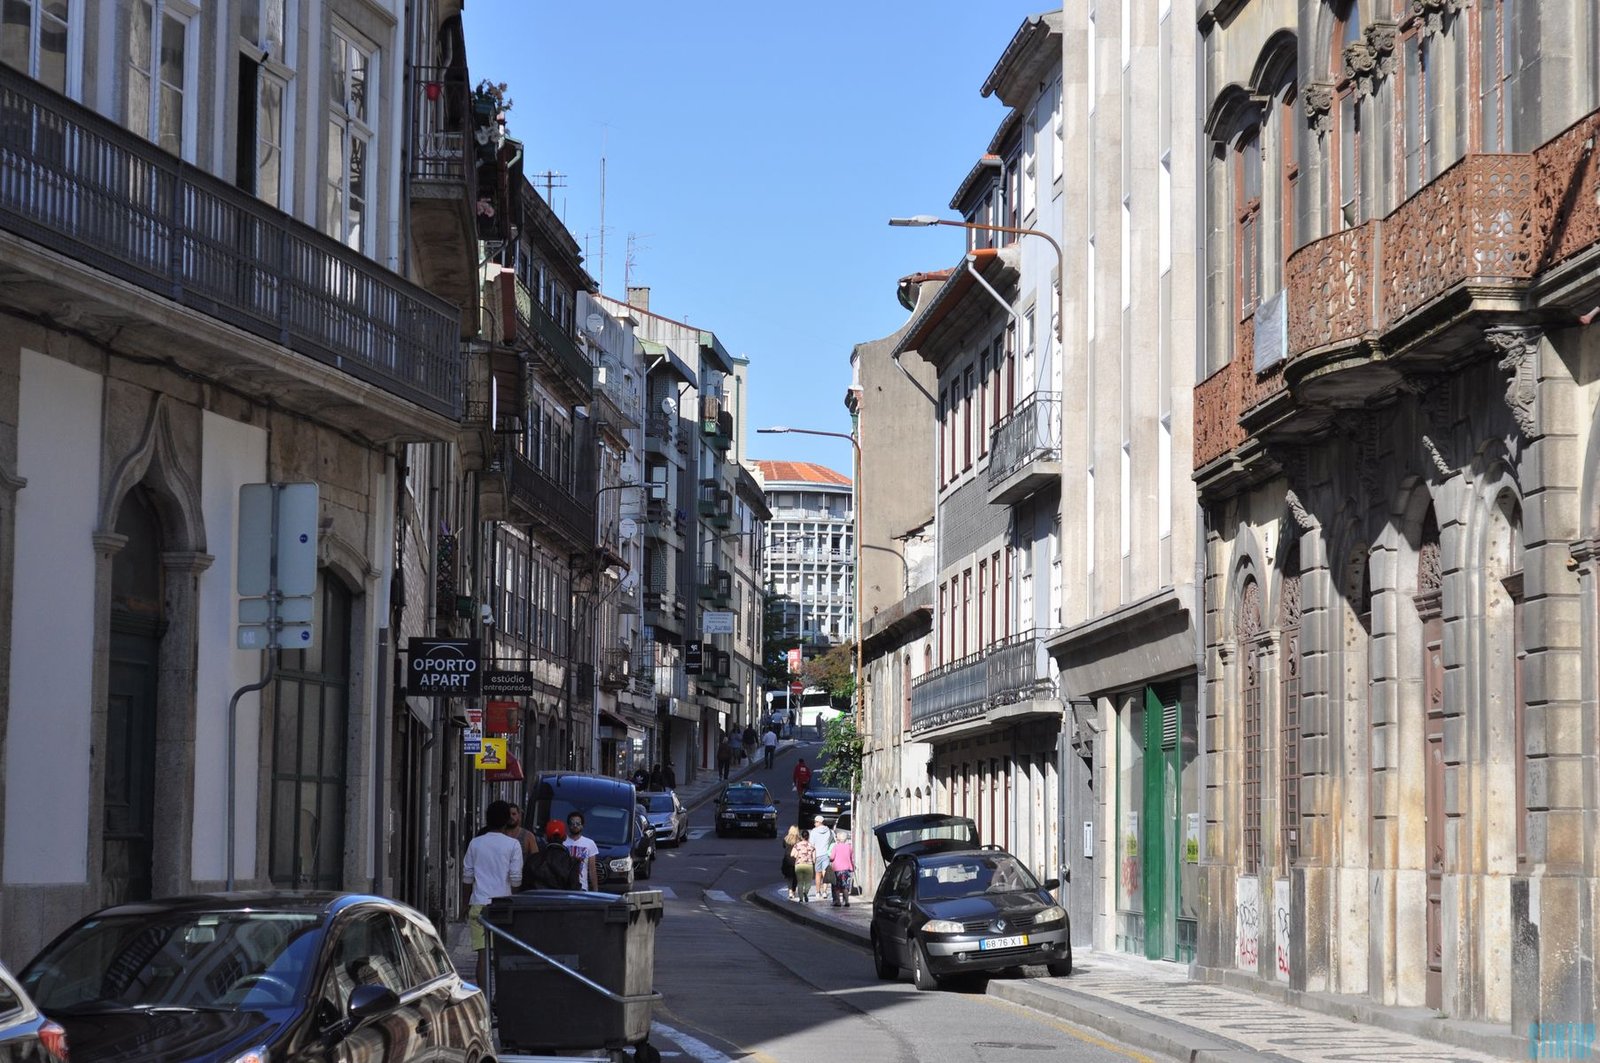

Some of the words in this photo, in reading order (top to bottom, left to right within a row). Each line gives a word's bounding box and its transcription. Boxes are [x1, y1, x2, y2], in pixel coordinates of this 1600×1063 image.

[413, 658, 477, 672] OPORTO
[420, 673, 470, 686] APART
[491, 674, 525, 683] estúdio
[483, 684, 532, 693] entreparedes
[986, 940, 996, 949] 68
[998, 938, 1008, 947] 76
